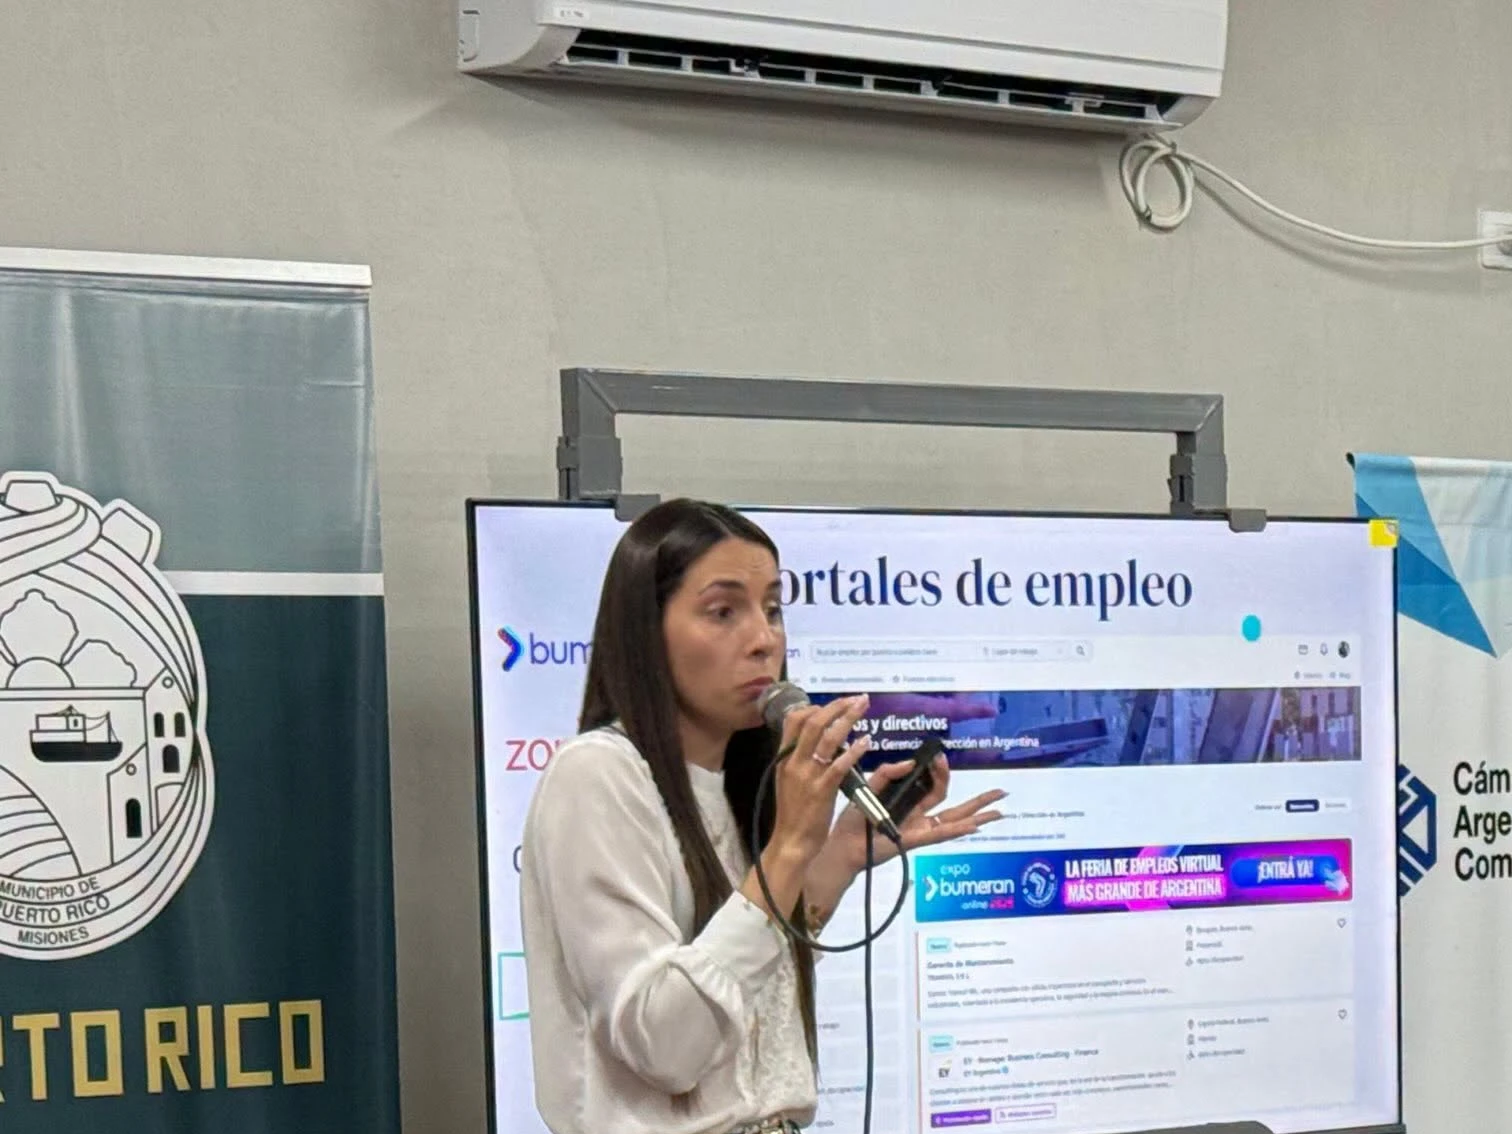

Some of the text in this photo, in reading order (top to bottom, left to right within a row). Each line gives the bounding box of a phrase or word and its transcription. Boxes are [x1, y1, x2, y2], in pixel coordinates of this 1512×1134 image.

[780, 556, 1192, 622] ortales de empleo
[870, 719, 880, 734] y
[882, 715, 949, 731] directivos
[979, 739, 991, 749] en
[992, 736, 1040, 751] Argentina
[940, 863, 971, 877] expo
[1065, 854, 1224, 878] LA FERIA DE EMPLEOS VIRTUAL
[0, 877, 100, 899] MUNICIPIO DE
[940, 878, 1015, 896] bumeran
[1069, 879, 1093, 903] MÁS
[1095, 881, 1144, 901] GRANDE
[1145, 881, 1160, 899] DE
[1161, 878, 1222, 898] ARGENTINA
[66, 893, 110, 920] RICO
[17, 926, 90, 945] MISIONES
[0, 999, 325, 1102] TO RICO
